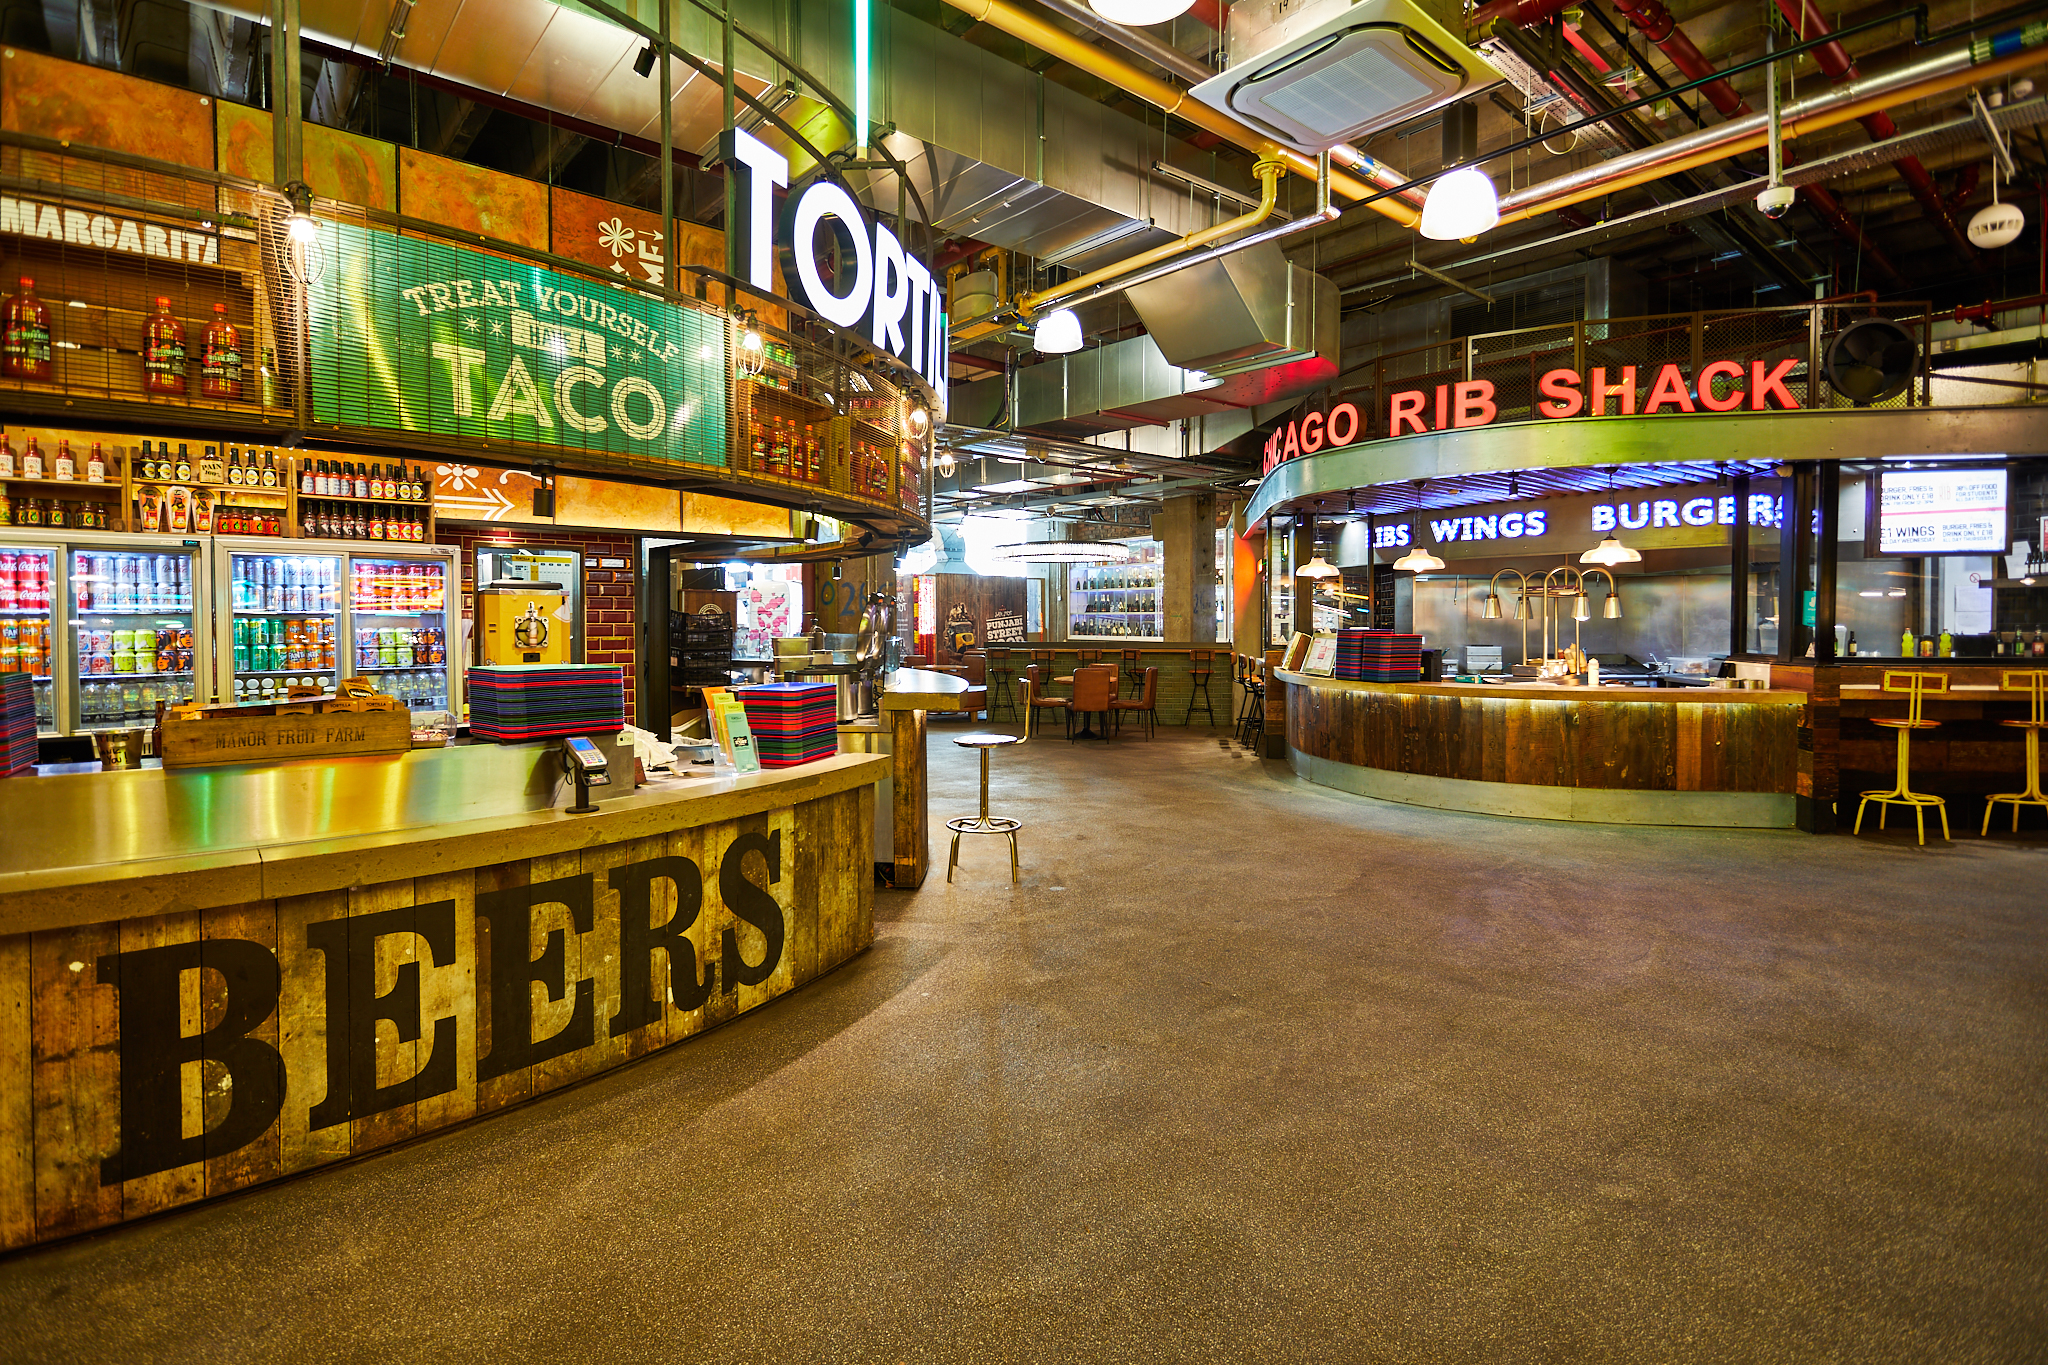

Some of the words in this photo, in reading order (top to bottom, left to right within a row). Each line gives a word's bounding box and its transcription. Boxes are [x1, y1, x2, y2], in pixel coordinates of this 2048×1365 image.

[402, 279, 522, 316] TREAT
[533, 284, 680, 363] YOURSELF
[432, 341, 667, 441] TACO
[1262, 402, 1360, 477] CHICAGO
[1390, 378, 1498, 437] RIB
[1538, 359, 1801, 419] SHACK
[1902, 493, 1920, 501] ONLY
[1430, 510, 1548, 544] WINGS
[1895, 525, 1936, 538] WINGS
[986, 618, 1023, 630] PUNJABI
[987, 626, 1024, 640] STREET
[215, 730, 267, 749] MANOR
[276, 729, 317, 746] FRUIT
[325, 725, 367, 743] FARM
[96, 828, 785, 1187] BEERS
